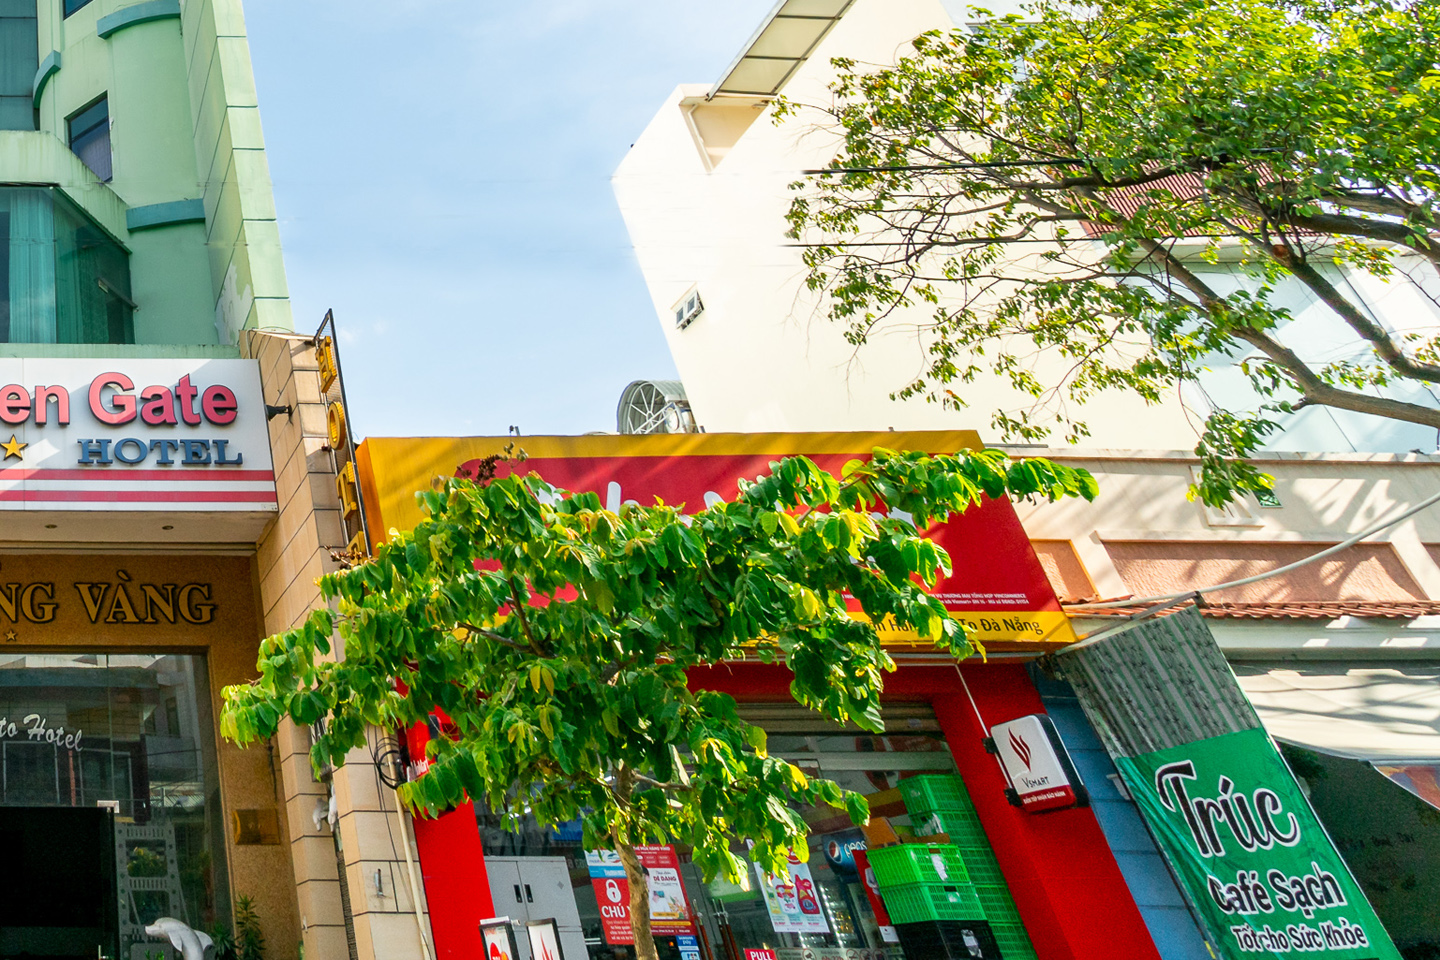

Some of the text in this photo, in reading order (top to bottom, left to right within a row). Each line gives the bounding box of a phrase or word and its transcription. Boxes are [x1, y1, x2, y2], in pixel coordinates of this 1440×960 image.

[87, 370, 239, 427] Gate
[76, 438, 244, 467] HOTEL
[73, 569, 217, 625] VÀNG
[980, 617, 1000, 632] Đà
[1005, 616, 1044, 635] Nẵng
[22, 713, 84, 752] Hotel
[1155, 759, 1301, 858] Trúc
[1207, 861, 1349, 919] Café Sạch
[601, 902, 626, 918] CHÚ
[1230, 922, 1261, 952] Tốt
[1257, 928, 1289, 952] cho
[1288, 925, 1324, 951] Sức
